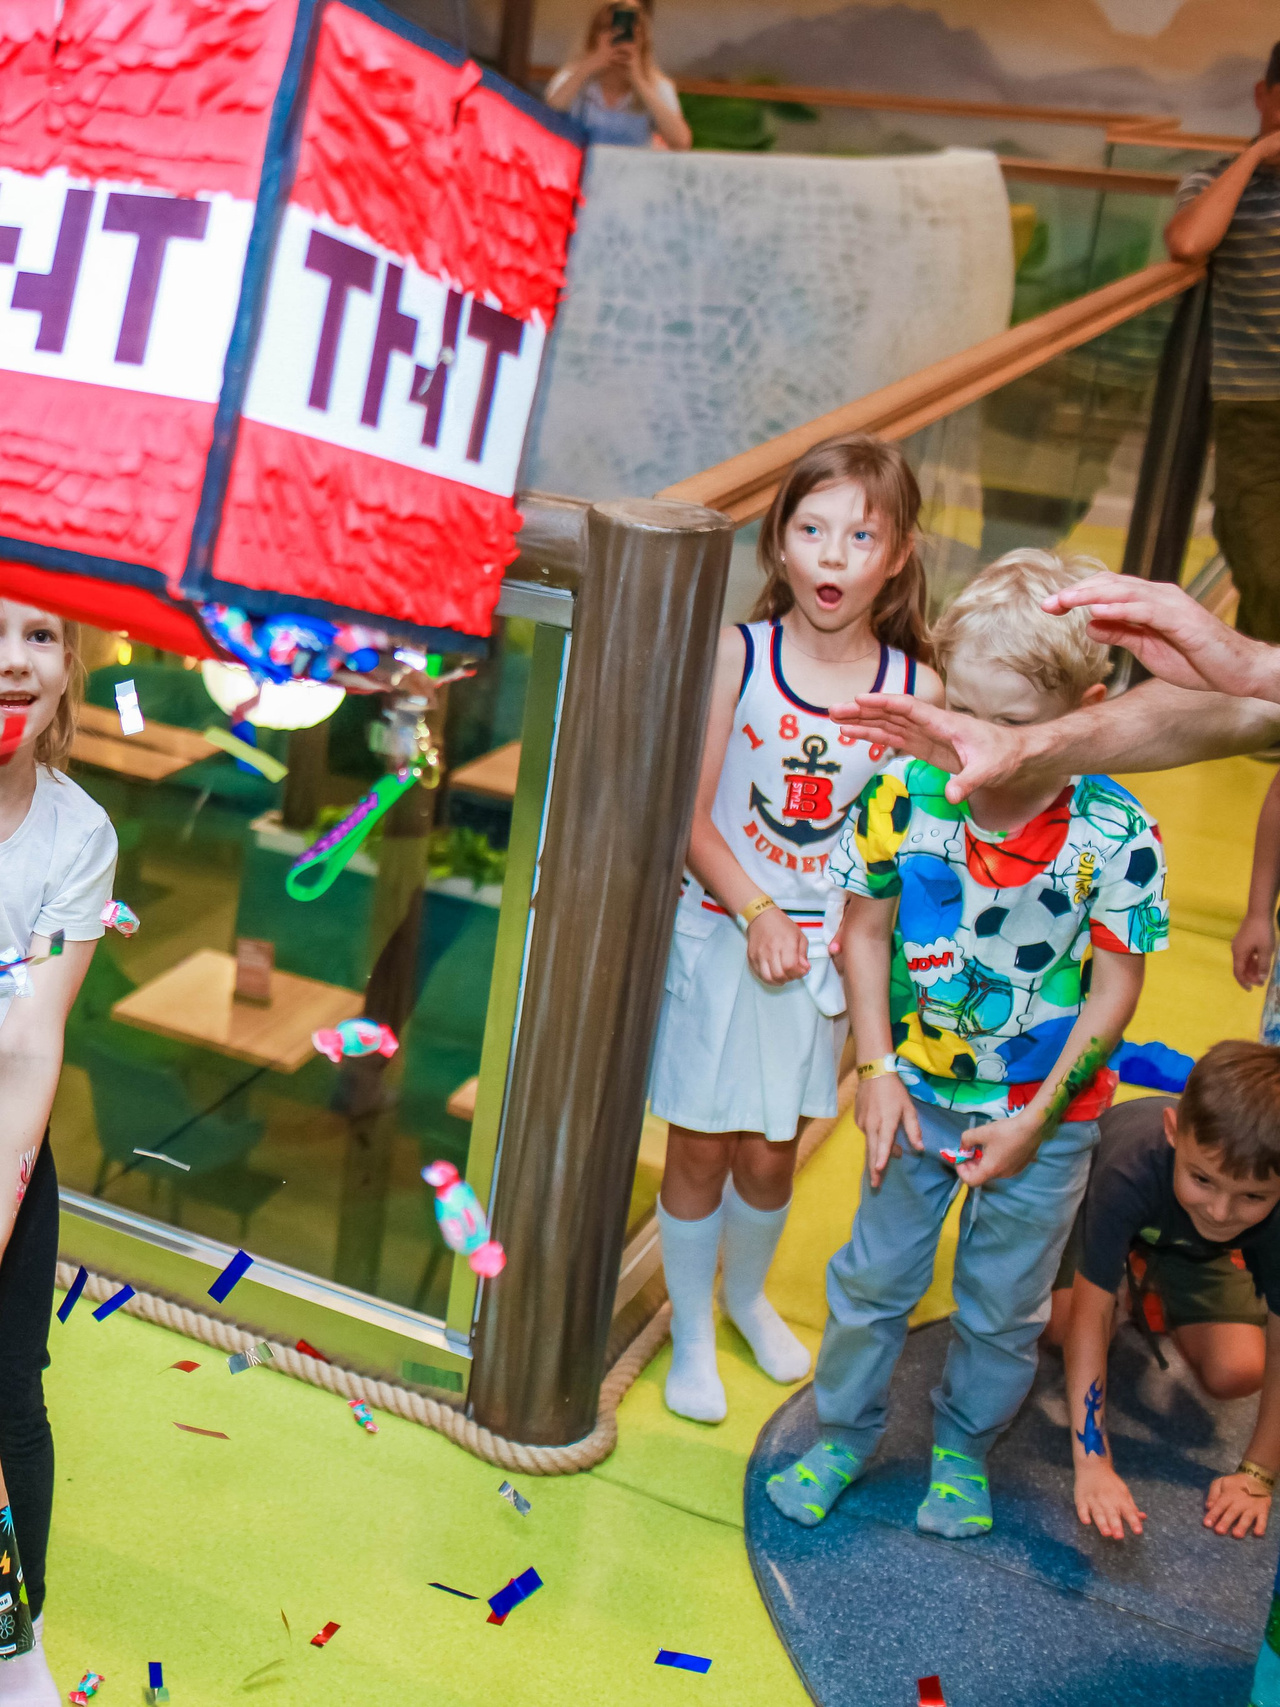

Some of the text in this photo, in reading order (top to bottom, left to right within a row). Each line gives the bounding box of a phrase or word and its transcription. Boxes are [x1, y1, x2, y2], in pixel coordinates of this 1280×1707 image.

[305, 228, 526, 464] TNT
[782, 774, 833, 820] B
[790, 782, 803, 810] STYLE
